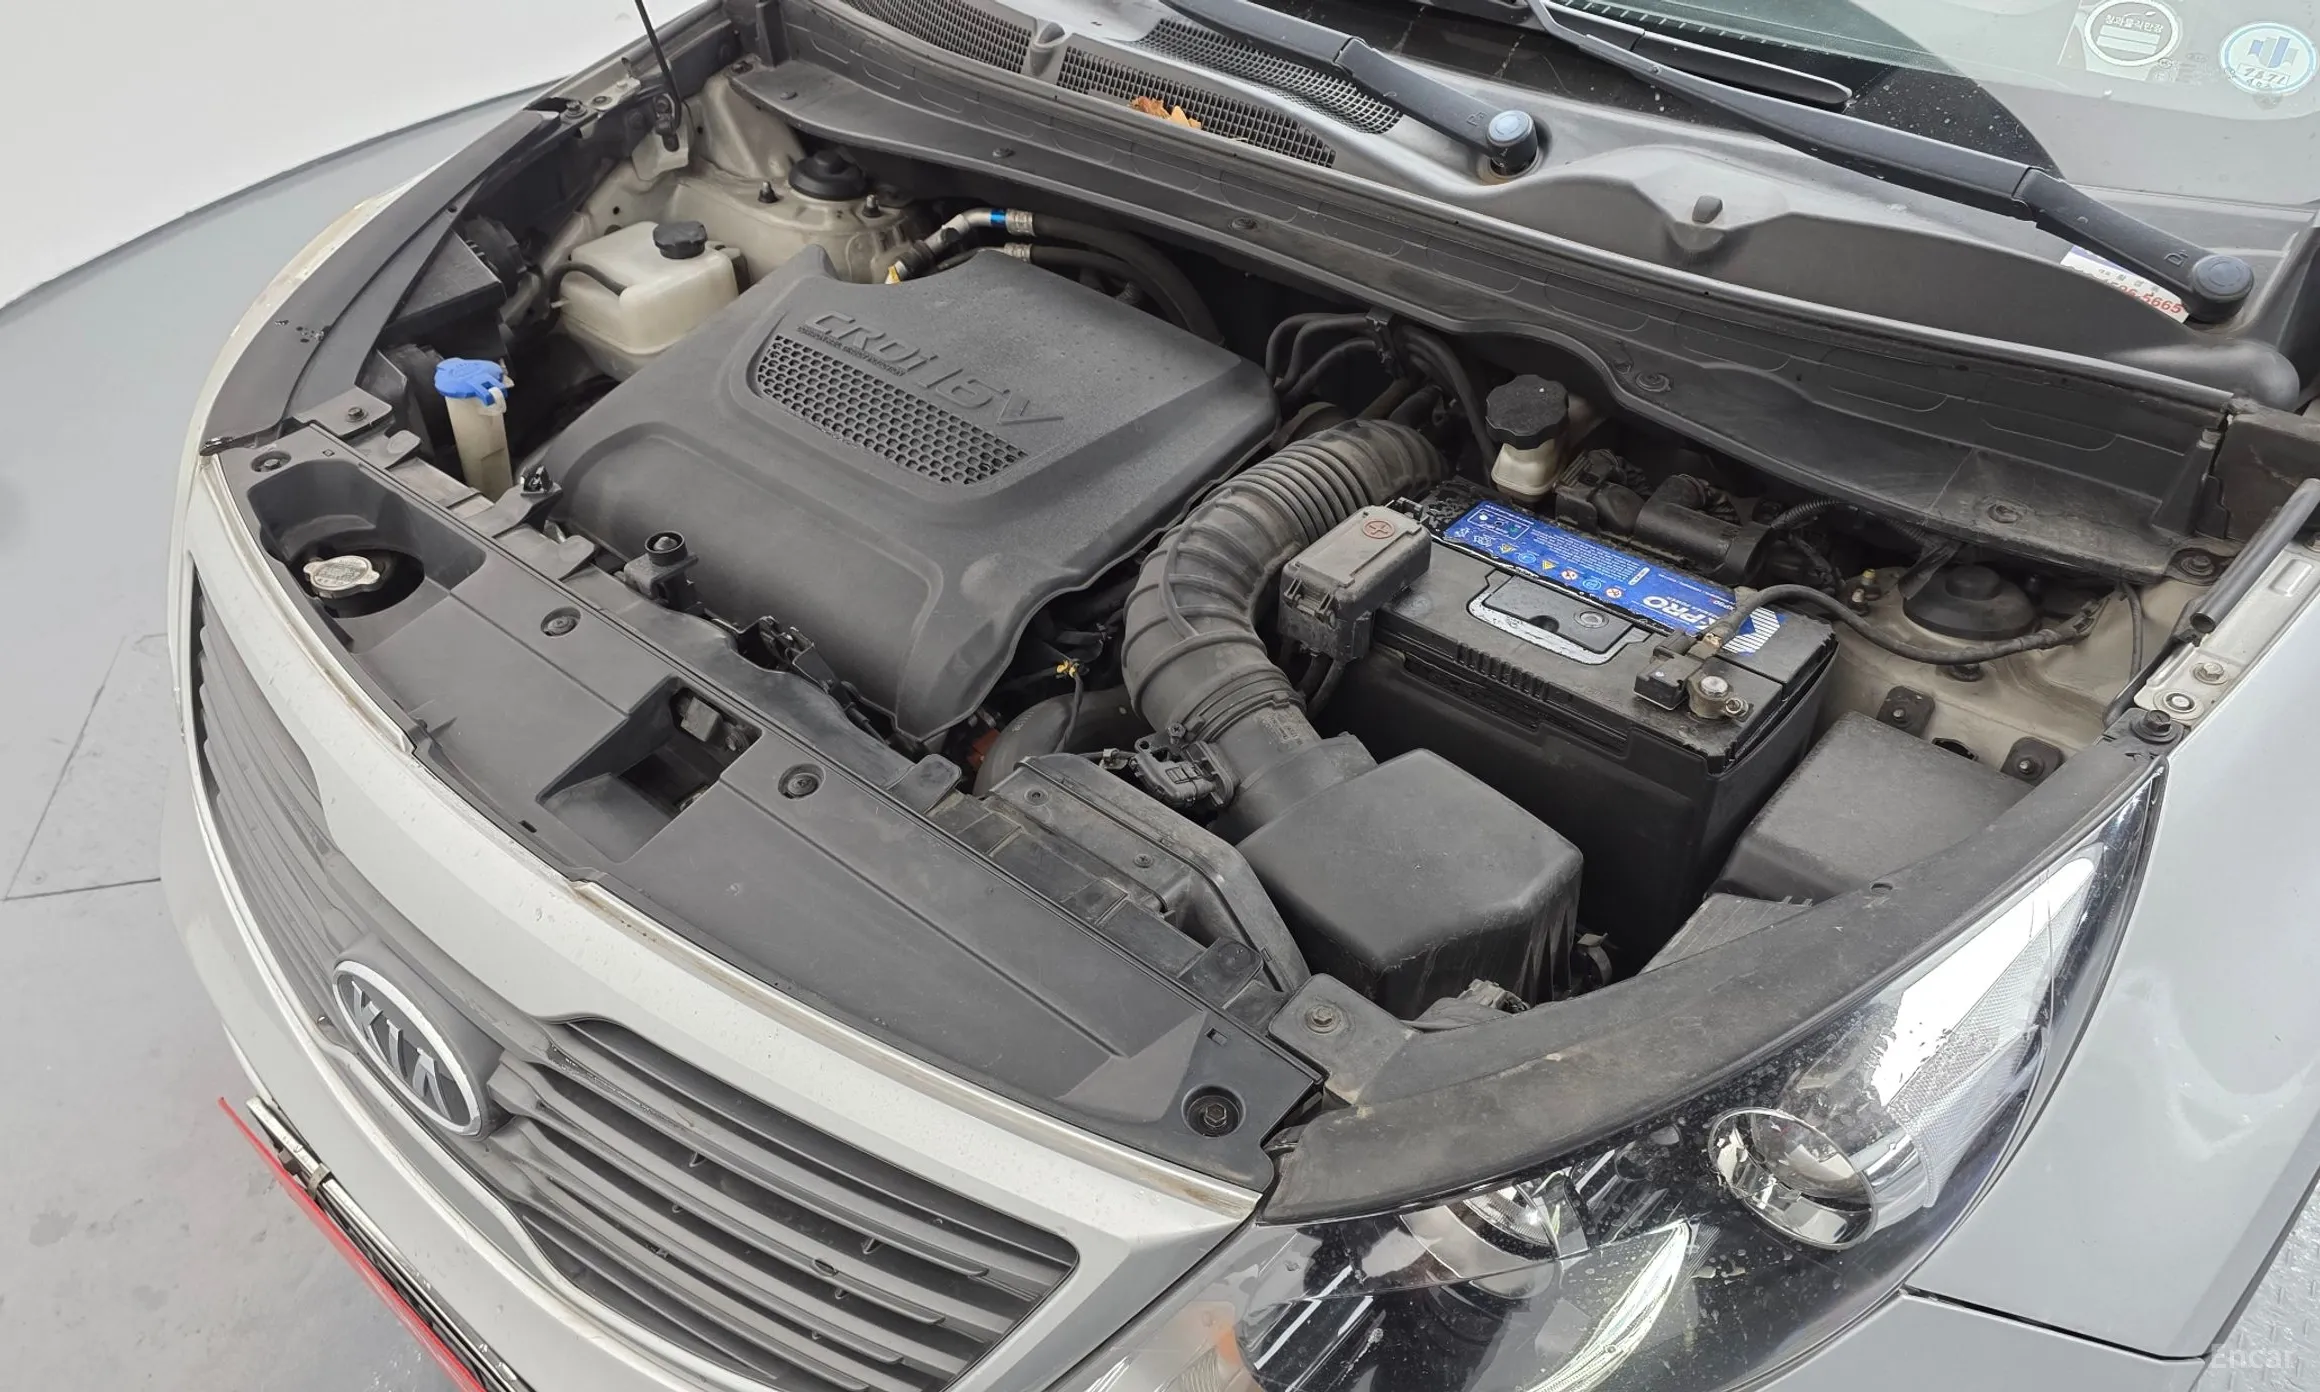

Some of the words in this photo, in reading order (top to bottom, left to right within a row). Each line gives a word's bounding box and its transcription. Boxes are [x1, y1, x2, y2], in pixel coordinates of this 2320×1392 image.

[801, 310, 939, 374] CRDi
[917, 367, 1065, 426] 16V
[351, 980, 454, 1121] KIA
